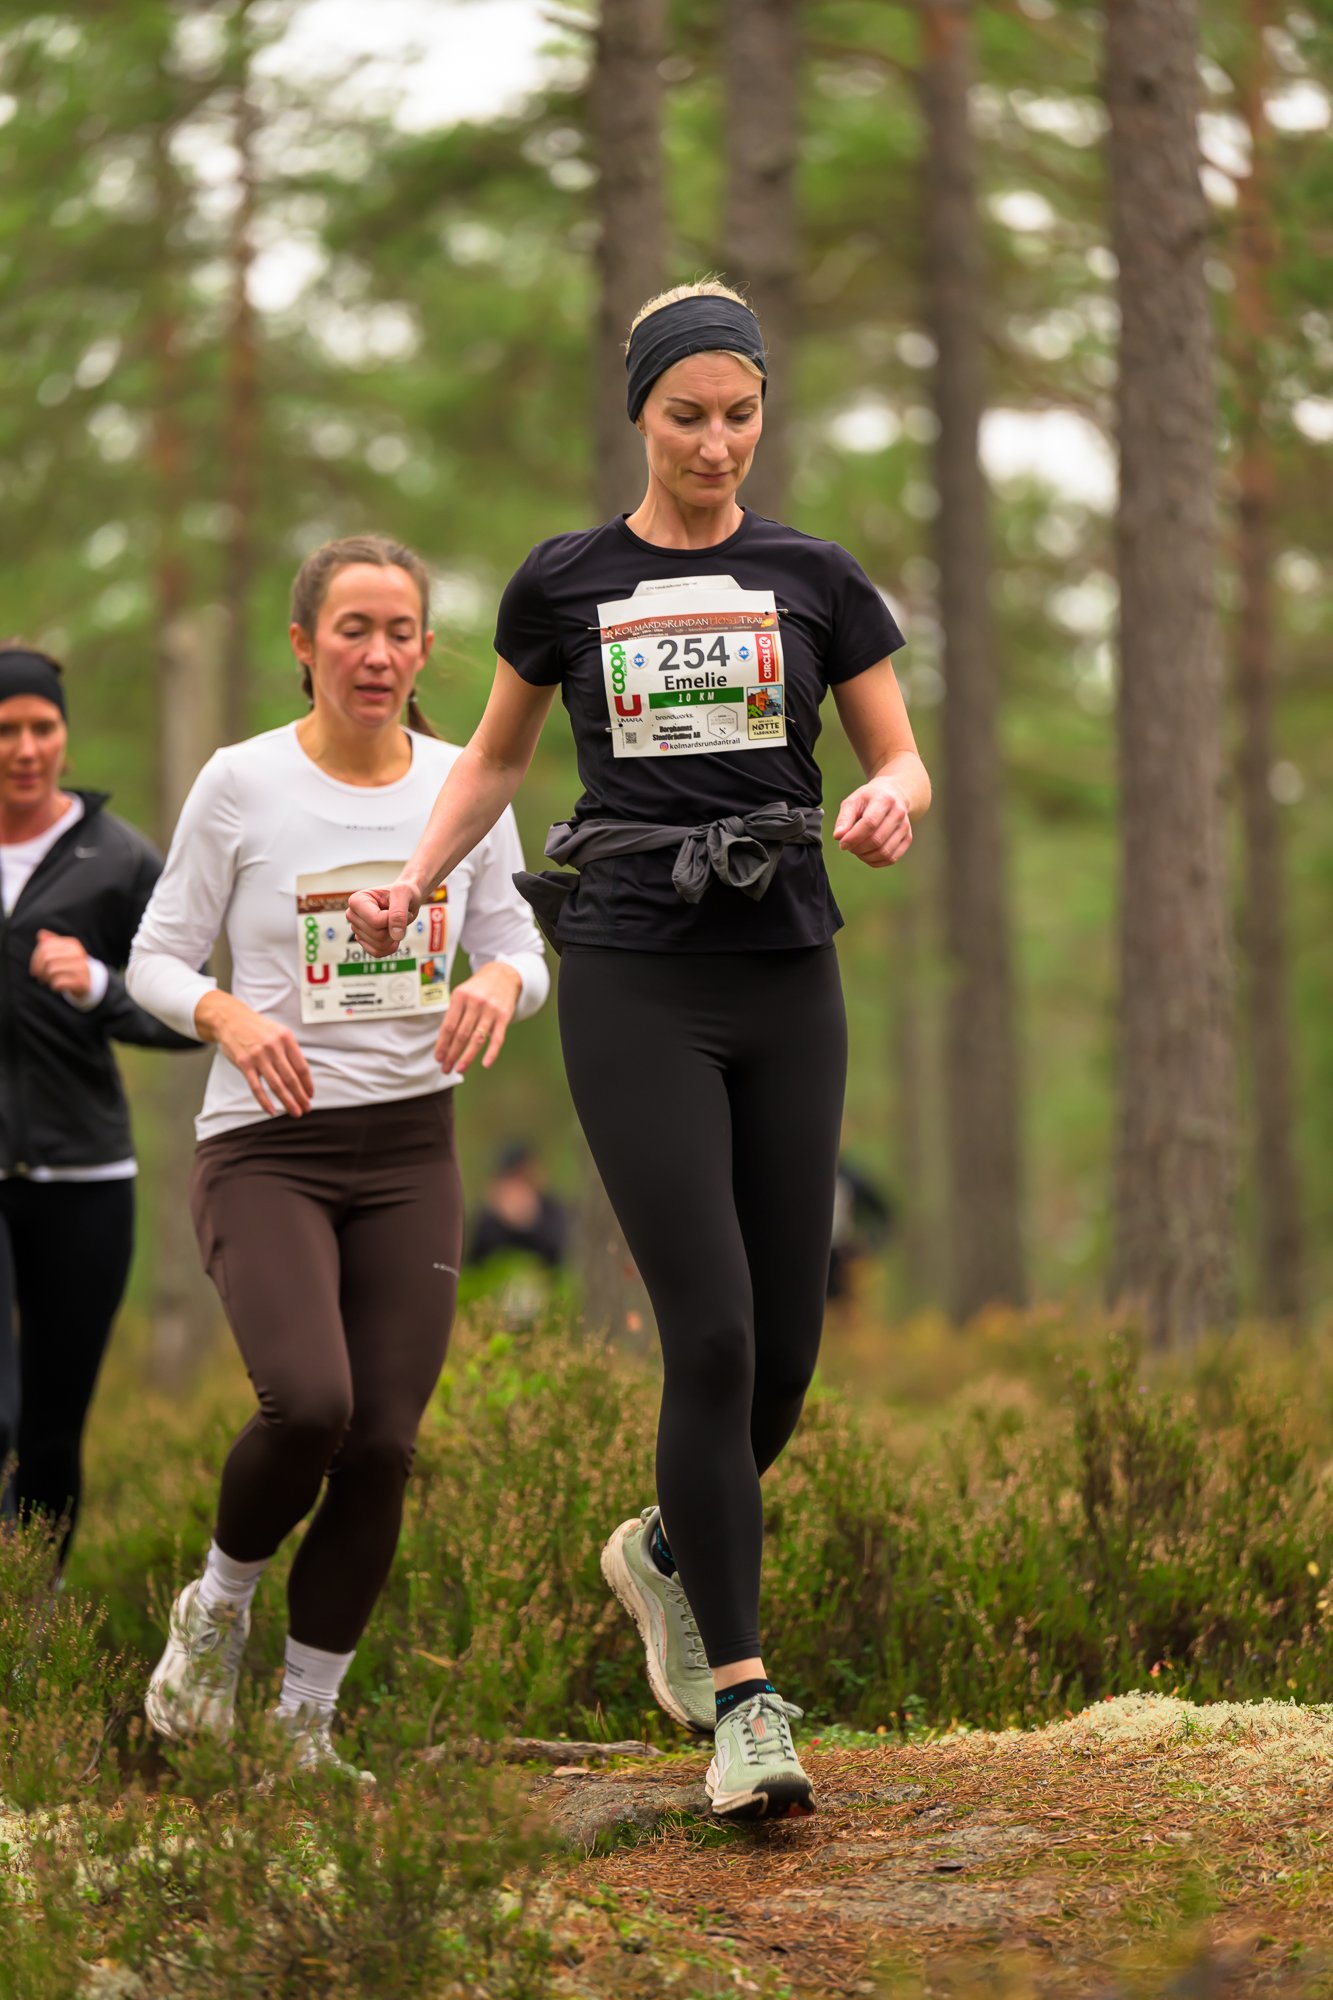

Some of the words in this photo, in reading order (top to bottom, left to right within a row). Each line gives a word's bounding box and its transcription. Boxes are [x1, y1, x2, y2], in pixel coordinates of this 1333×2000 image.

[657, 636, 730, 671] 254
[610, 643, 626, 694] coop
[762, 648, 772, 679] CIRCLE
[664, 672, 728, 690] Emelie
[678, 693, 692, 703] 10
[699, 691, 715, 701] KM
[752, 722, 780, 731] NØTTE
[669, 738, 741, 750] kolmardsrundantrail
